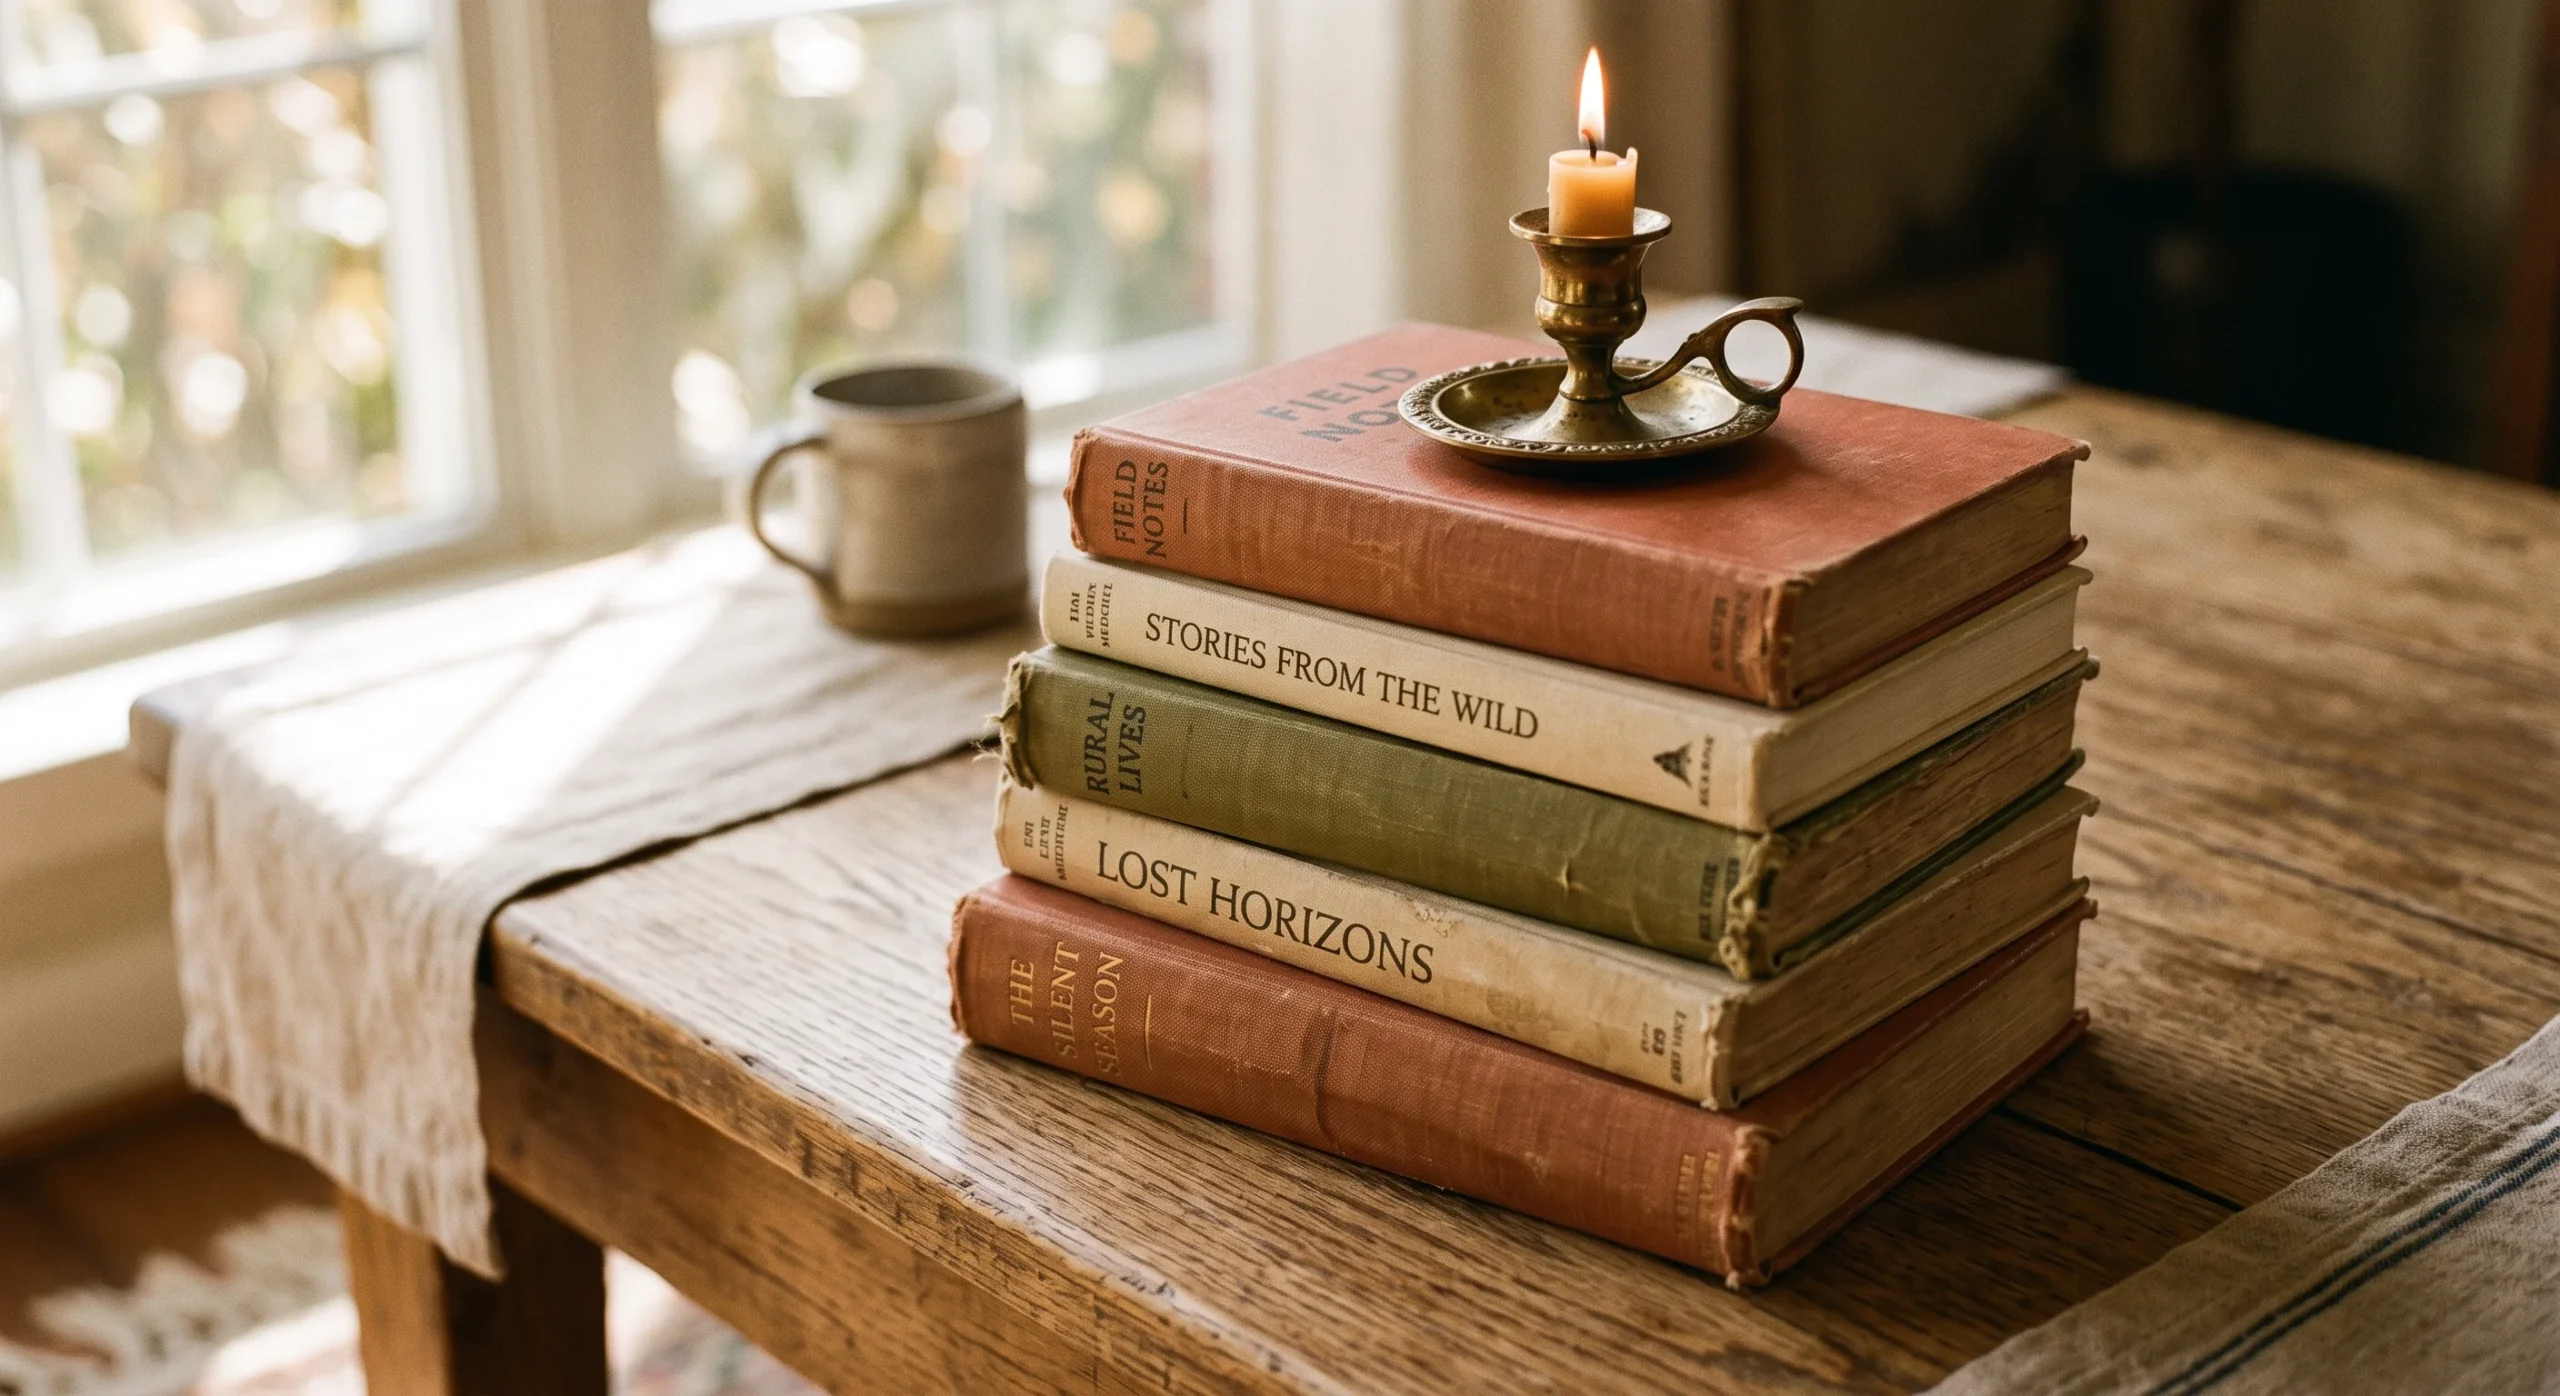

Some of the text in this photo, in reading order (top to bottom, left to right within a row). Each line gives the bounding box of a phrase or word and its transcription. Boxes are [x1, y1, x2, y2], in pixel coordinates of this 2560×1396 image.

[1257, 367, 1418, 421] FIELD
[1113, 460, 1137, 544] FIELD
[1142, 461, 1168, 559] NOTES
[1145, 613, 1267, 670] STORIES
[1276, 645, 1366, 696] FROM
[1376, 671, 1440, 715] THE
[1451, 690, 1539, 740] WILD
[1084, 692, 1115, 795] RURAL
[1118, 704, 1146, 795] LIVES
[1097, 840, 1197, 906] LOST
[1209, 877, 1434, 984] HORIZONS
[1010, 959, 1034, 1025] THE
[1050, 941, 1080, 1059] SILENT
[1092, 951, 1124, 1076] SEASON
